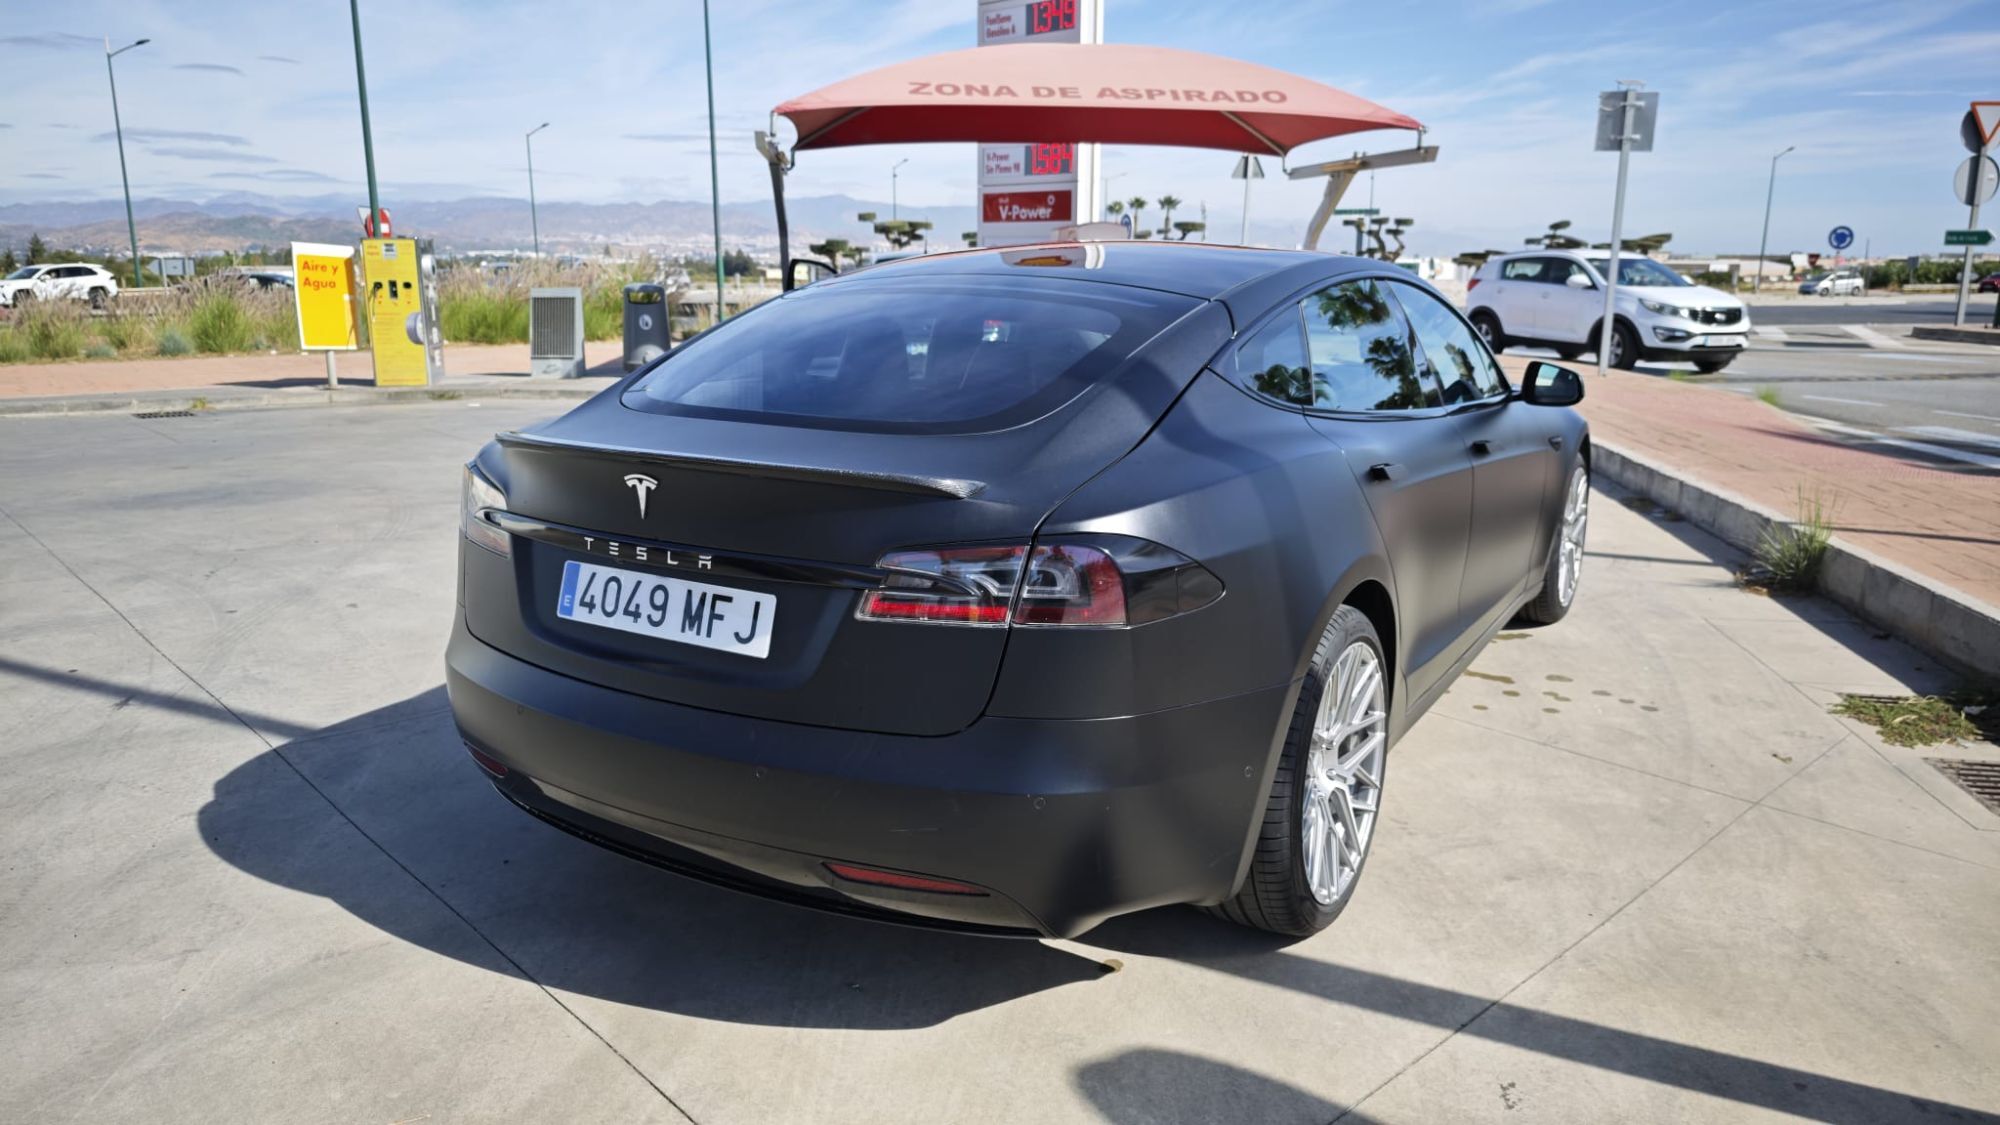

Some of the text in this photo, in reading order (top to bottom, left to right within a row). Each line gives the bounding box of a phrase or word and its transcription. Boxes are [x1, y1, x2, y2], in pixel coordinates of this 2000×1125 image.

[908, 82, 1288, 104] ZONA DE ASPIRADO
[999, 204, 1053, 220] V-Power
[302, 260, 338, 274] Aire y
[303, 277, 337, 290] Agua
[584, 537, 712, 570] TESLA
[563, 594, 571, 607] E
[579, 572, 761, 645] 4049 MFJ
